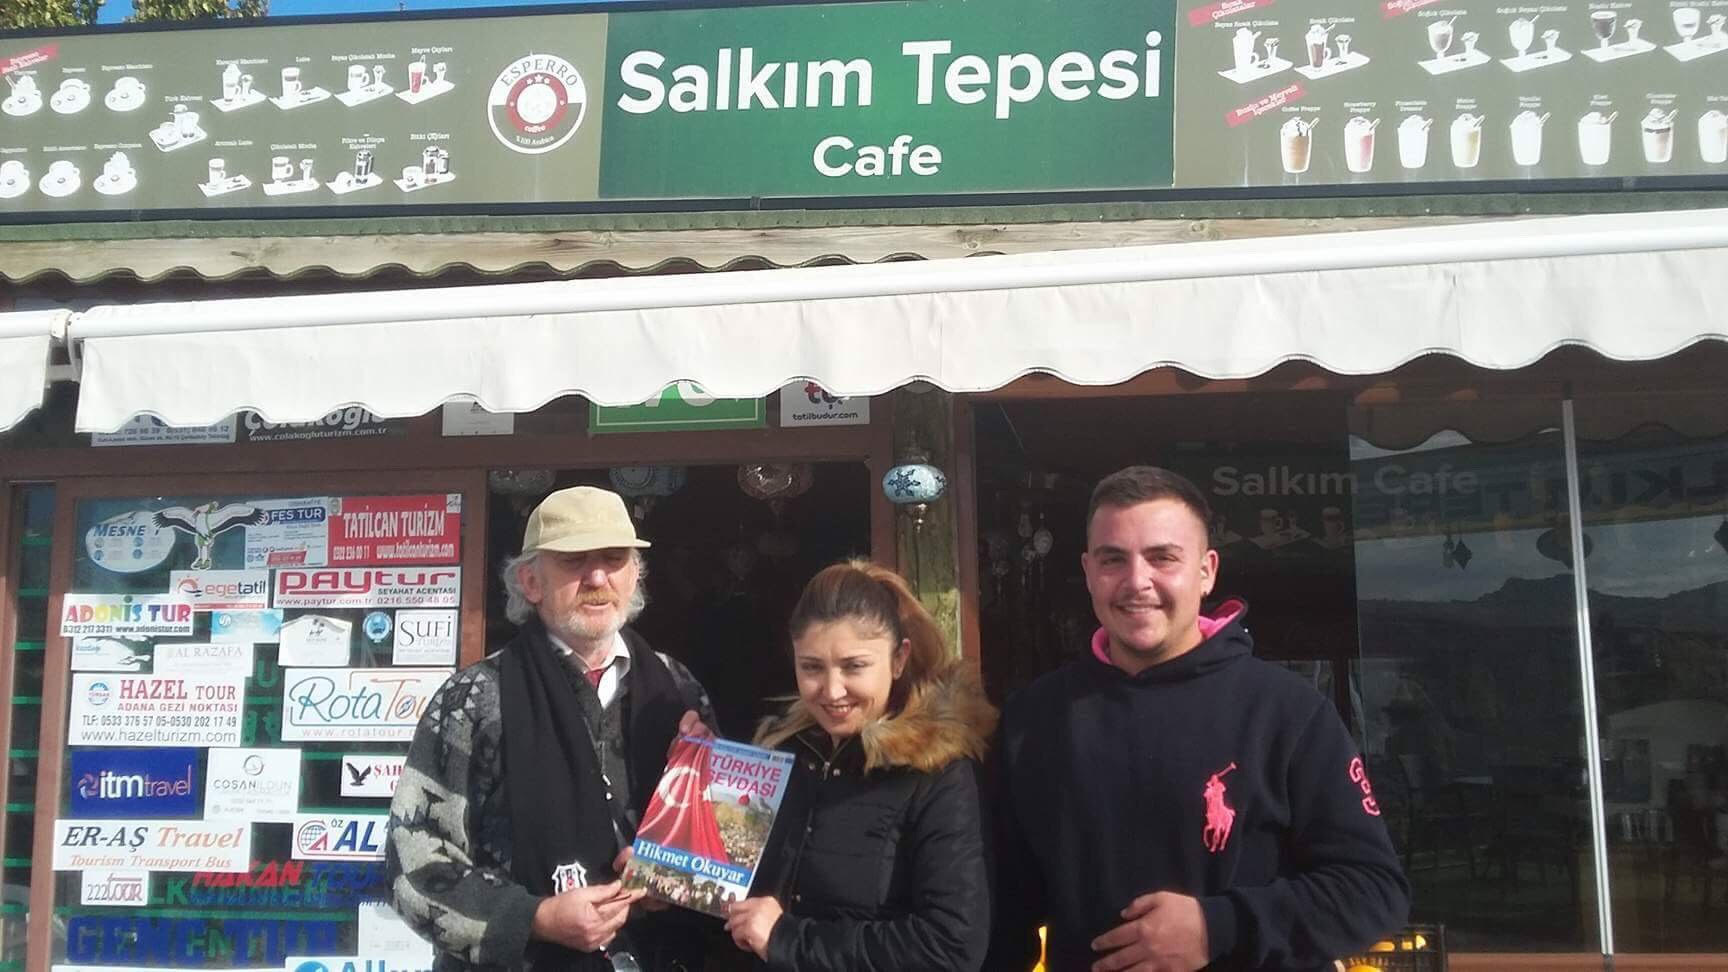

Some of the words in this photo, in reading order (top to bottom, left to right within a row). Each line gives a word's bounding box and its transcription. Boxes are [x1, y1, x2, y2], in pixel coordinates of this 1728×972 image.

[500, 58, 578, 87] ESPERRO
[616, 47, 873, 115] Salkım
[901, 29, 1164, 121] Tepesi
[812, 134, 944, 178] Cafe
[1212, 465, 1359, 496] Salkım
[1374, 464, 1480, 496] Cafe
[271, 510, 295, 521] FES
[297, 508, 322, 519] TUR
[343, 504, 399, 539] TATİLCAN
[401, 503, 445, 538] TURİZM
[93, 523, 147, 537] MESNE
[205, 579, 266, 597] egetatil
[378, 588, 414, 596] SEYAHAT
[416, 587, 456, 595] ACENTASI
[277, 597, 372, 607] www.paytur.com.tr
[376, 596, 402, 605] 0216
[148, 604, 190, 623] TUR
[115, 624, 191, 634] www.adonistur.com
[175, 647, 189, 657] AL
[193, 645, 243, 657] RAZAFA
[119, 679, 188, 700] HAZEL
[195, 685, 236, 700] TOUR
[117, 703, 155, 712] ADANA
[160, 701, 185, 712] GEZİ
[189, 703, 238, 713] NOKTASI
[213, 716, 223, 728] 17
[81, 727, 236, 743] www.hazelturizm.com
[710, 752, 783, 783] TÜRKİYE
[707, 769, 777, 799] SEVDASI
[331, 818, 344, 828] ÖZ
[61, 826, 149, 852] ER-AŞ
[157, 826, 244, 849] Travel
[69, 855, 124, 867] Tourism
[130, 855, 202, 869] Transport
[207, 856, 232, 868] Bus
[636, 839, 689, 869] Hikmet
[690, 851, 745, 885] Okuyar
